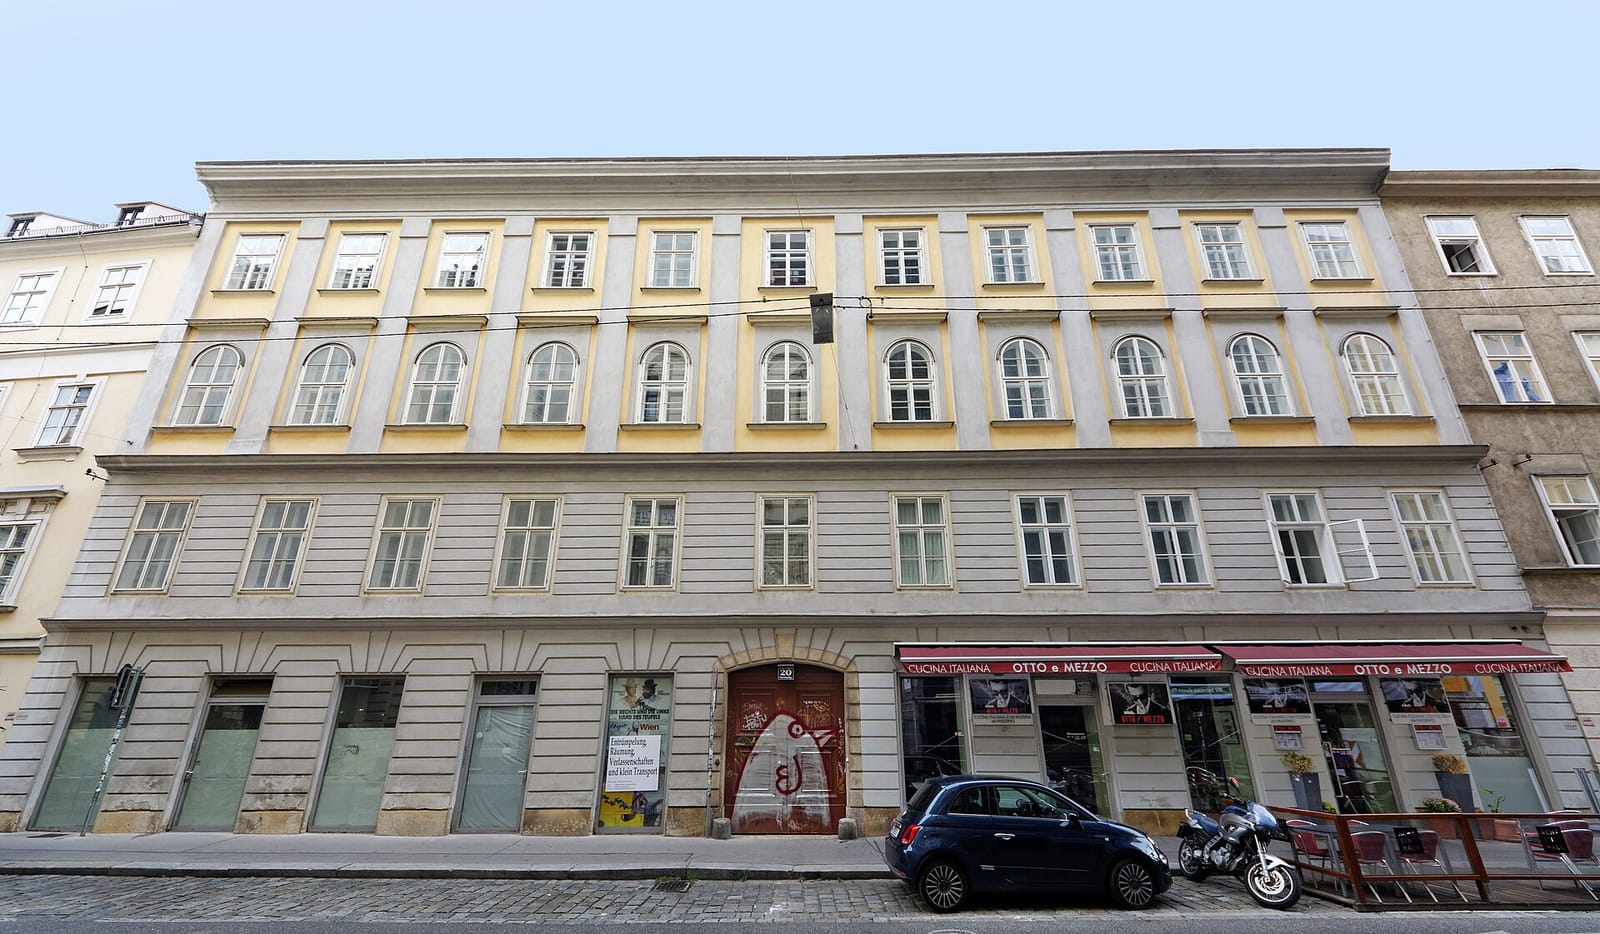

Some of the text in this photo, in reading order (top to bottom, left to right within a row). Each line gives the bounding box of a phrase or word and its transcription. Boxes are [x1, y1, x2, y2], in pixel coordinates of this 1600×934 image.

[908, 663, 991, 674] CUCINA ITALIANA
[1012, 662, 1108, 673] OTTO e MEZZO
[1129, 661, 1216, 672] CUCINA ITALIANA
[1245, 666, 1333, 676] CUCINA ITALIANA
[1354, 664, 1390, 675] OTTO
[1406, 663, 1452, 674] MEZZO
[1474, 663, 1565, 674] CUCINA ITALIANA
[779, 669, 793, 677] 20
[640, 723, 659, 731] Wien
[610, 756, 653, 766] Verlassenschaften
[608, 766, 658, 778] und klein Transport
